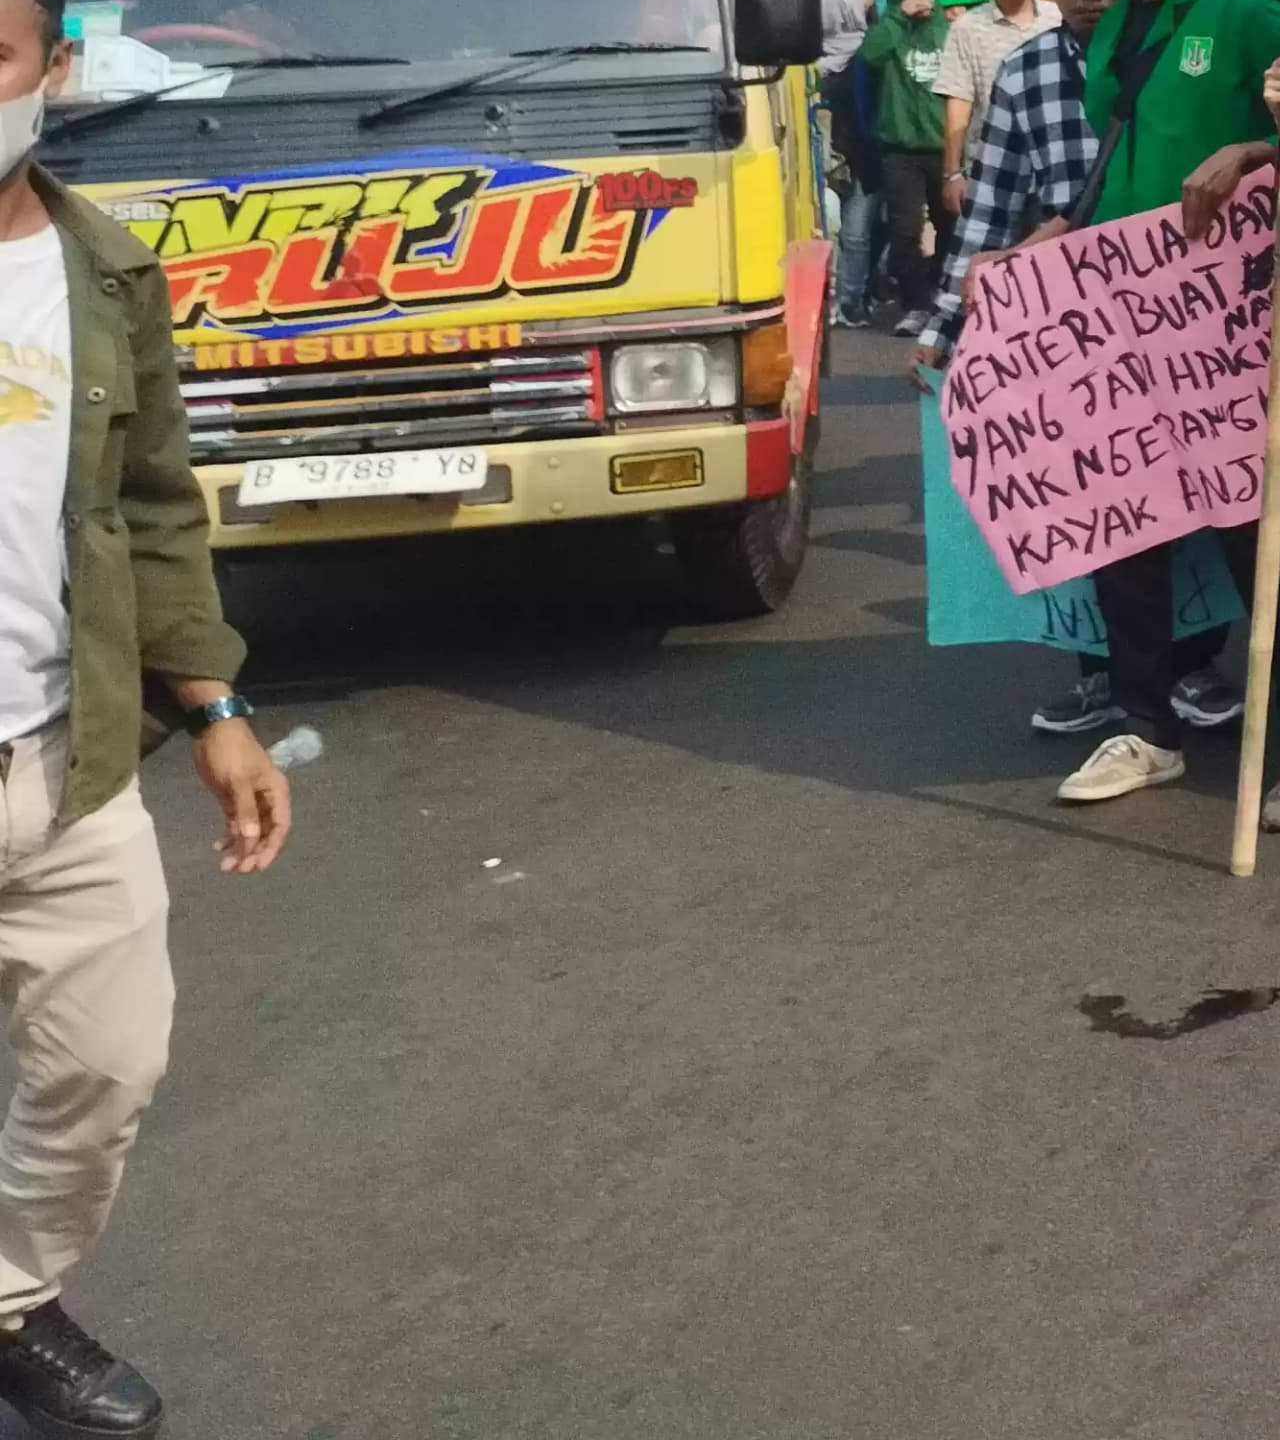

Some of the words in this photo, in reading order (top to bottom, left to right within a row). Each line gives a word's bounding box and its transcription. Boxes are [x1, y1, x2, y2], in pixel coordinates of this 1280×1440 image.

[1060, 219, 1190, 300] KALIA
[194, 323, 522, 370] MITSUBISHI
[947, 308, 1115, 418] MENTERI
[1112, 261, 1229, 338] BUAT
[951, 393, 1065, 497] YANG
[1069, 349, 1159, 417] JADI
[254, 463, 275, 489] B
[306, 458, 397, 484] 9788
[987, 466, 1070, 523] MK
[1007, 496, 1159, 577] KAYAK
